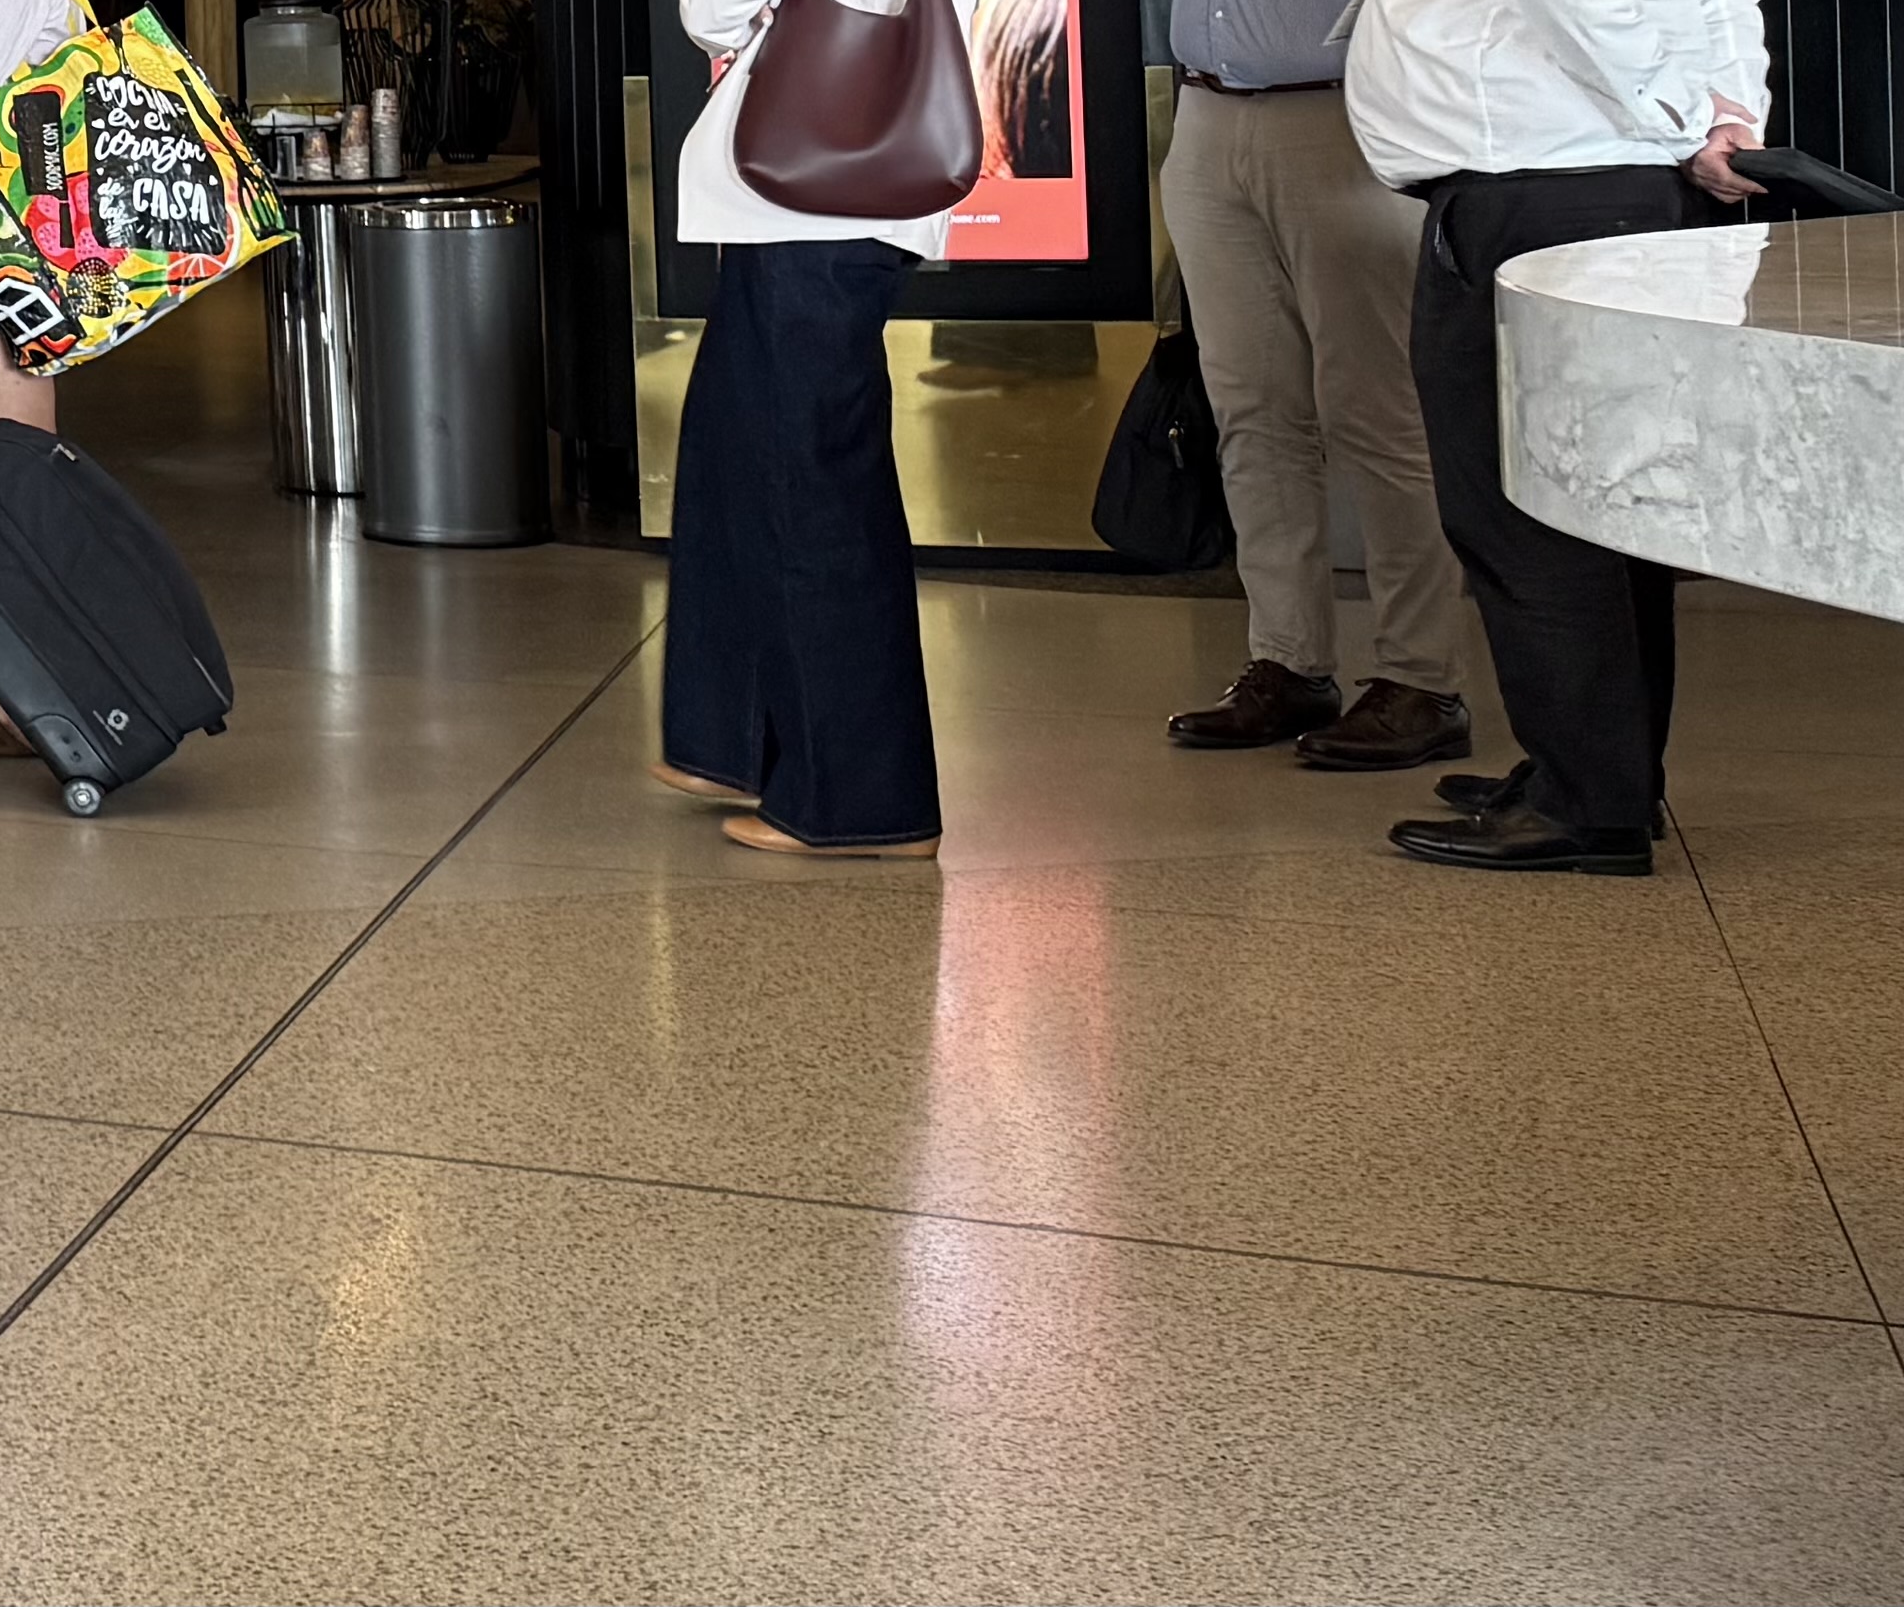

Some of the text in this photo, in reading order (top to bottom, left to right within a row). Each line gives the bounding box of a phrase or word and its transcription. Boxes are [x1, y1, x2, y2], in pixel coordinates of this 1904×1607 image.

[144, 110, 171, 132] el
[94, 128, 207, 174] corazón
[97, 177, 125, 196] de
[132, 177, 210, 225] CASA
